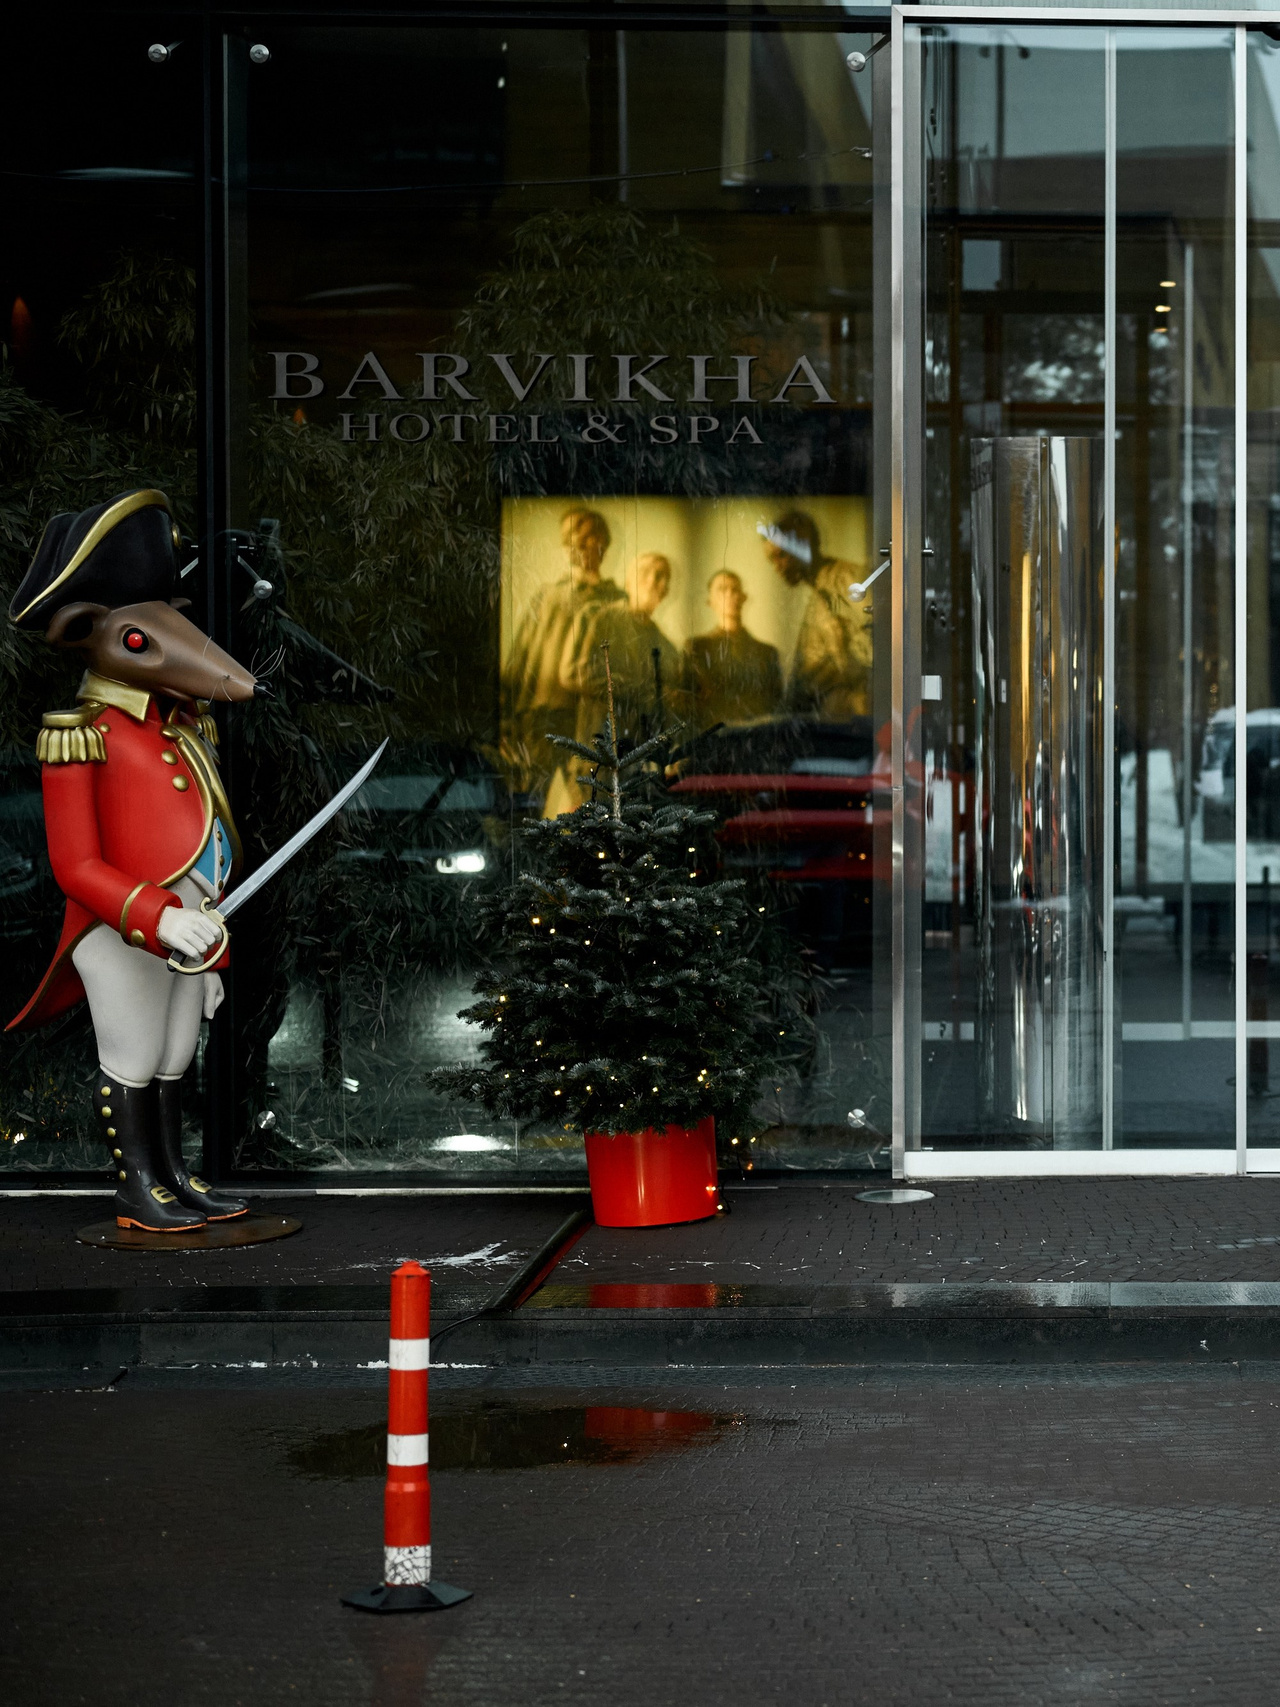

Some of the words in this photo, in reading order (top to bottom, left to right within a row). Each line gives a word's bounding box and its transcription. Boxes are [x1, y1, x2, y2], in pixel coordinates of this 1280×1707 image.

[268, 351, 837, 403] BARVIKHA
[340, 412, 560, 444] HOTEL
[580, 414, 627, 444] &
[649, 415, 764, 445] SPA
